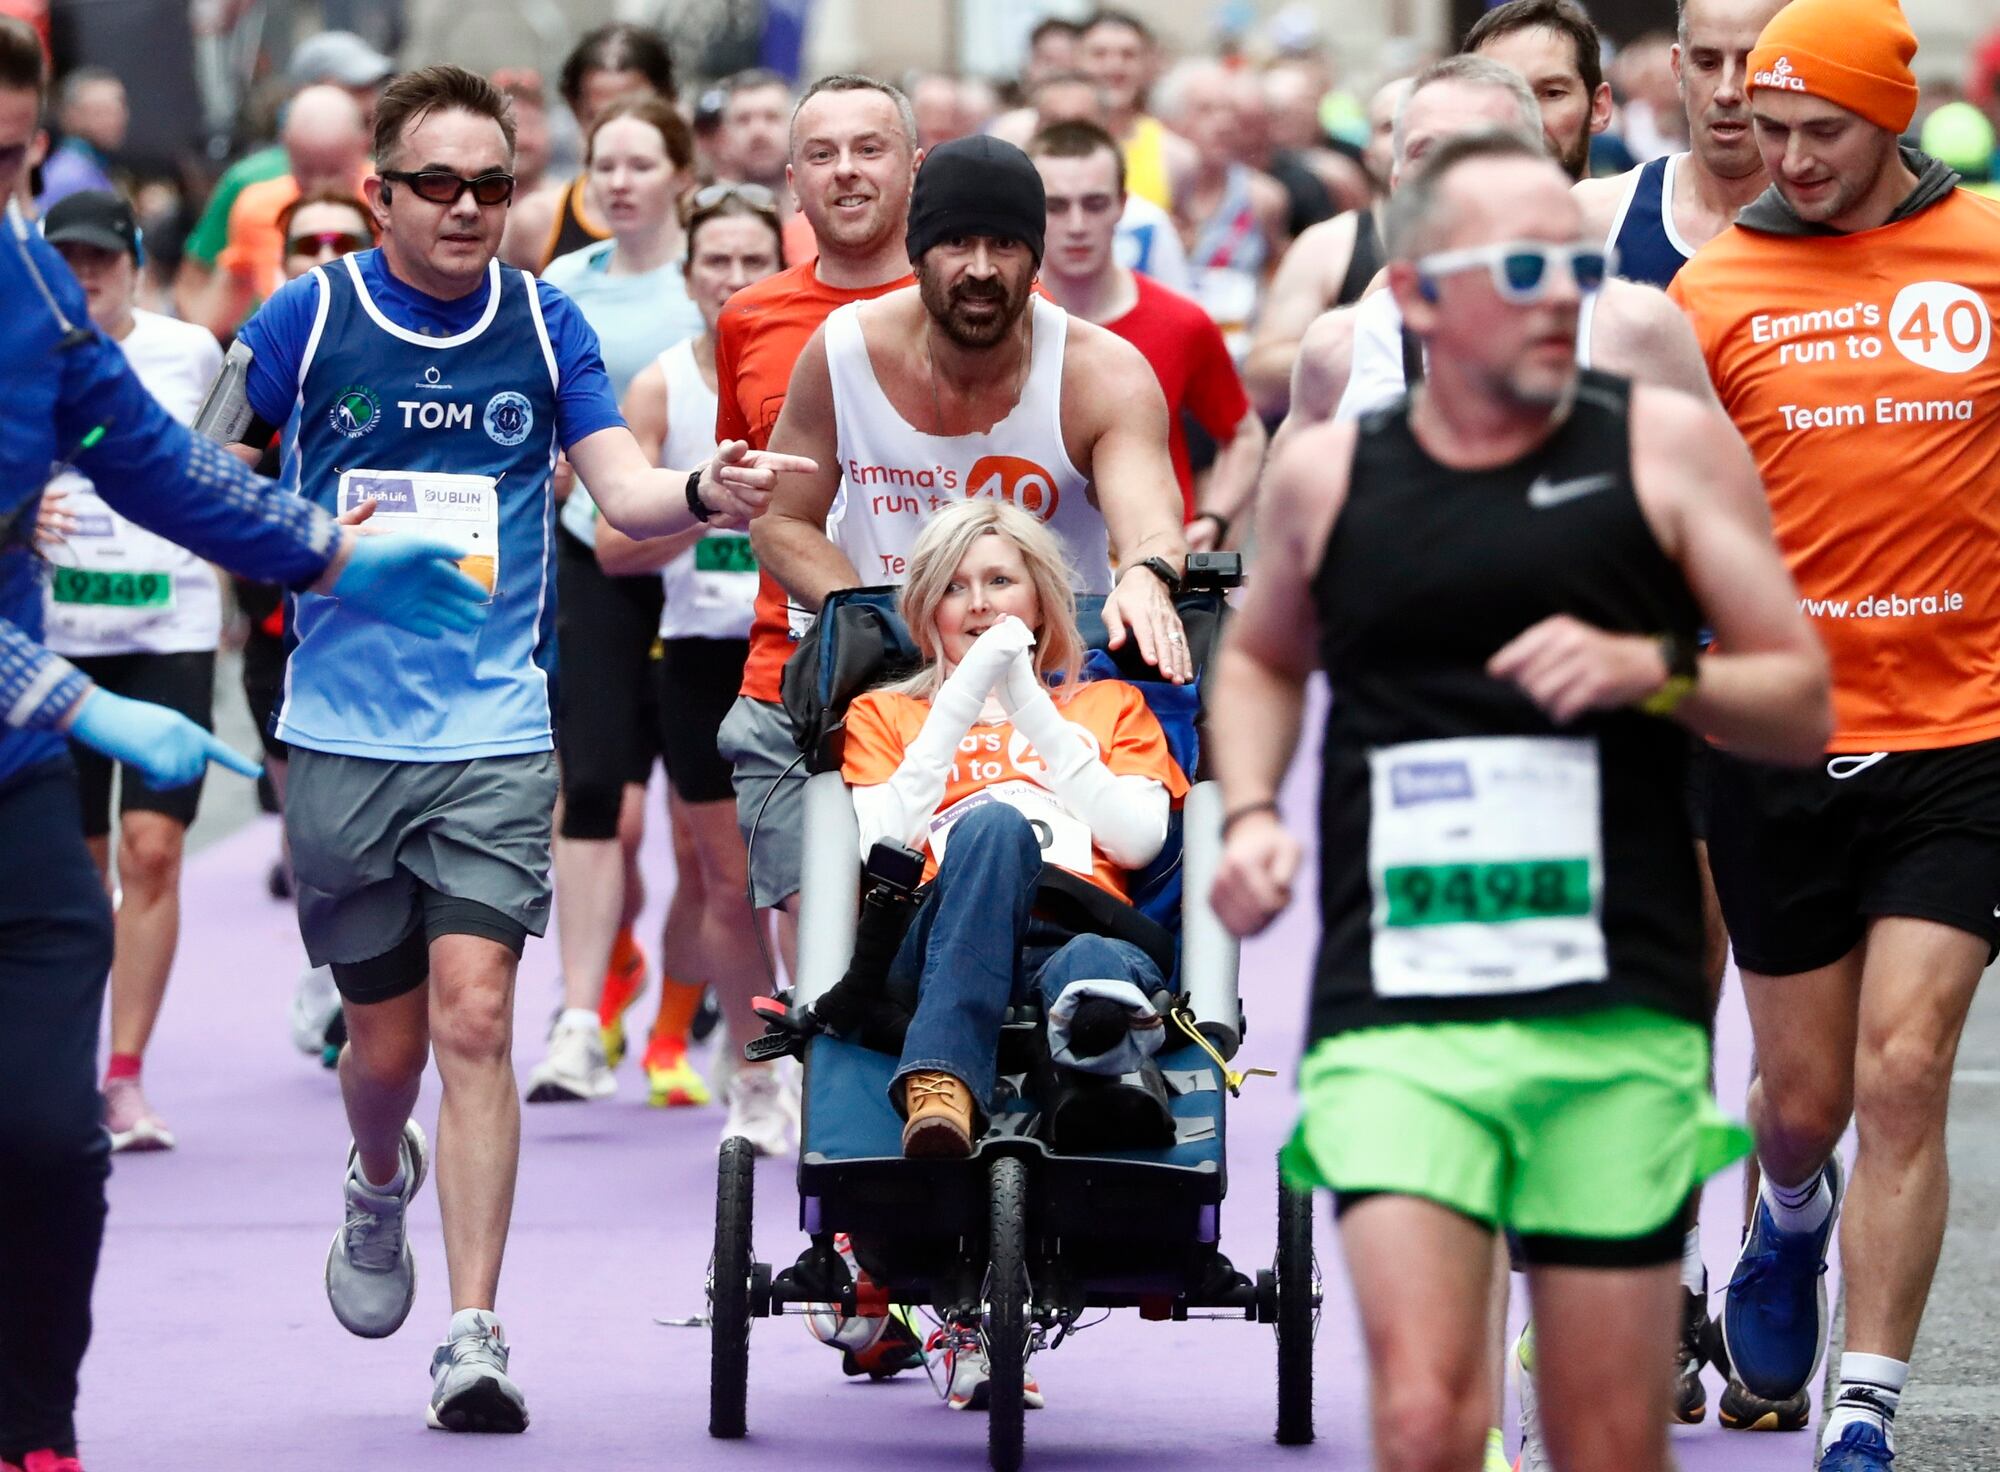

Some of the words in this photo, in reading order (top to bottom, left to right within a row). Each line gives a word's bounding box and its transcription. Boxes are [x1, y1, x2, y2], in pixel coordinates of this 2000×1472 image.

[1752, 302, 1881, 344] Emma's
[1898, 299, 1982, 354] 40
[1780, 341, 1835, 365] run
[1846, 335, 1882, 359] to
[398, 401, 474, 430] TOM
[1778, 404, 1865, 431] Team
[1875, 398, 1973, 424] Emma
[850, 459, 957, 490] Emma's
[366, 490, 389, 503] Irish
[389, 490, 408, 503] Life
[424, 489, 481, 504] DUBLIN
[873, 493, 919, 516] run
[879, 553, 906, 577] Te
[968, 760, 1003, 781] to
[1402, 867, 1568, 919] 9498
